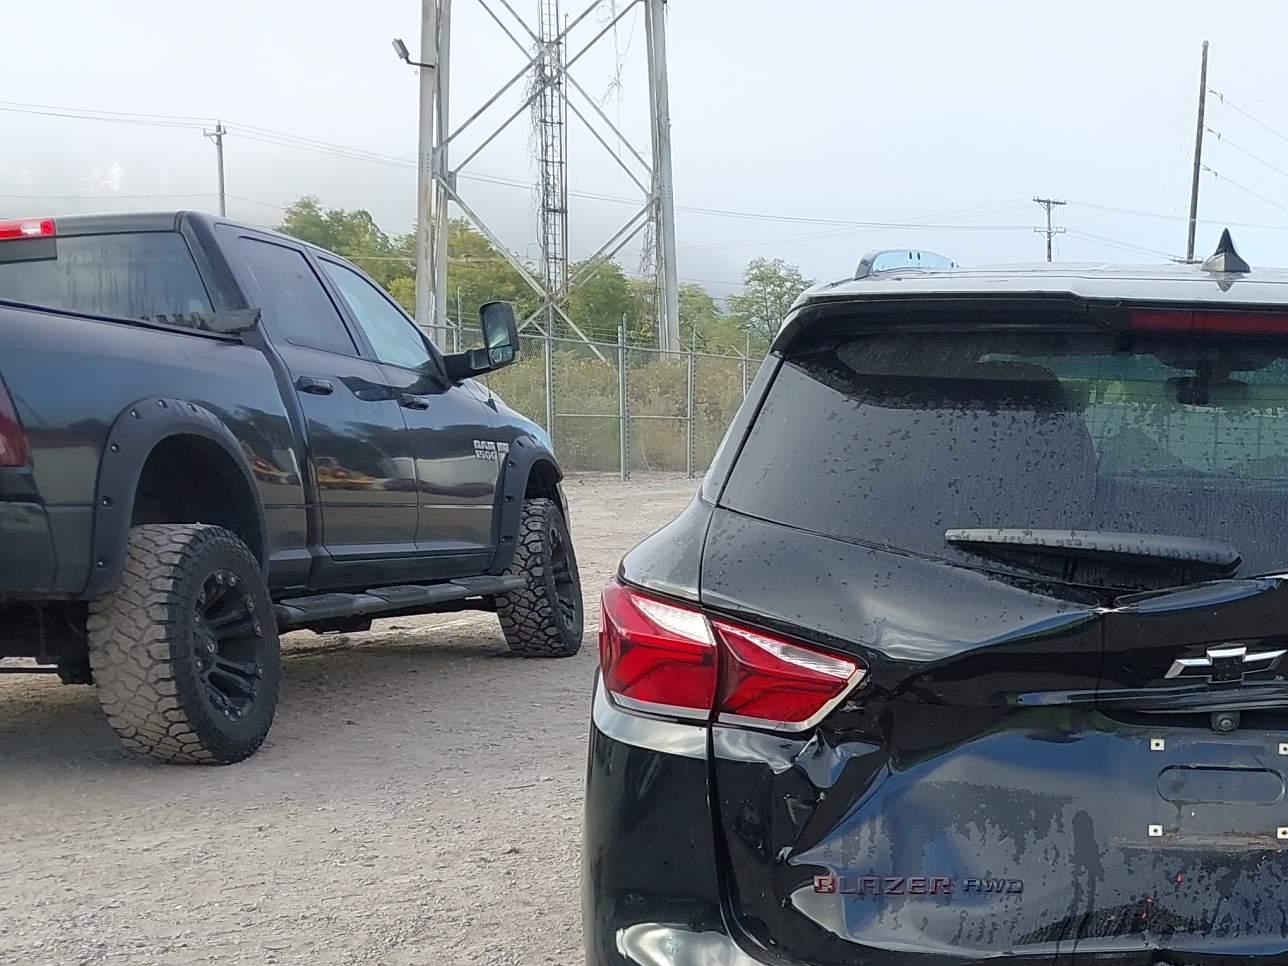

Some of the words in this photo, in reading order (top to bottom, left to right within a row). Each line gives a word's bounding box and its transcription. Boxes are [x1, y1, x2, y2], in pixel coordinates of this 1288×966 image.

[473, 440, 496, 450] RAM
[475, 450, 498, 460] 1500
[814, 875, 952, 895] BLAZER
[963, 878, 1024, 894] AWD
